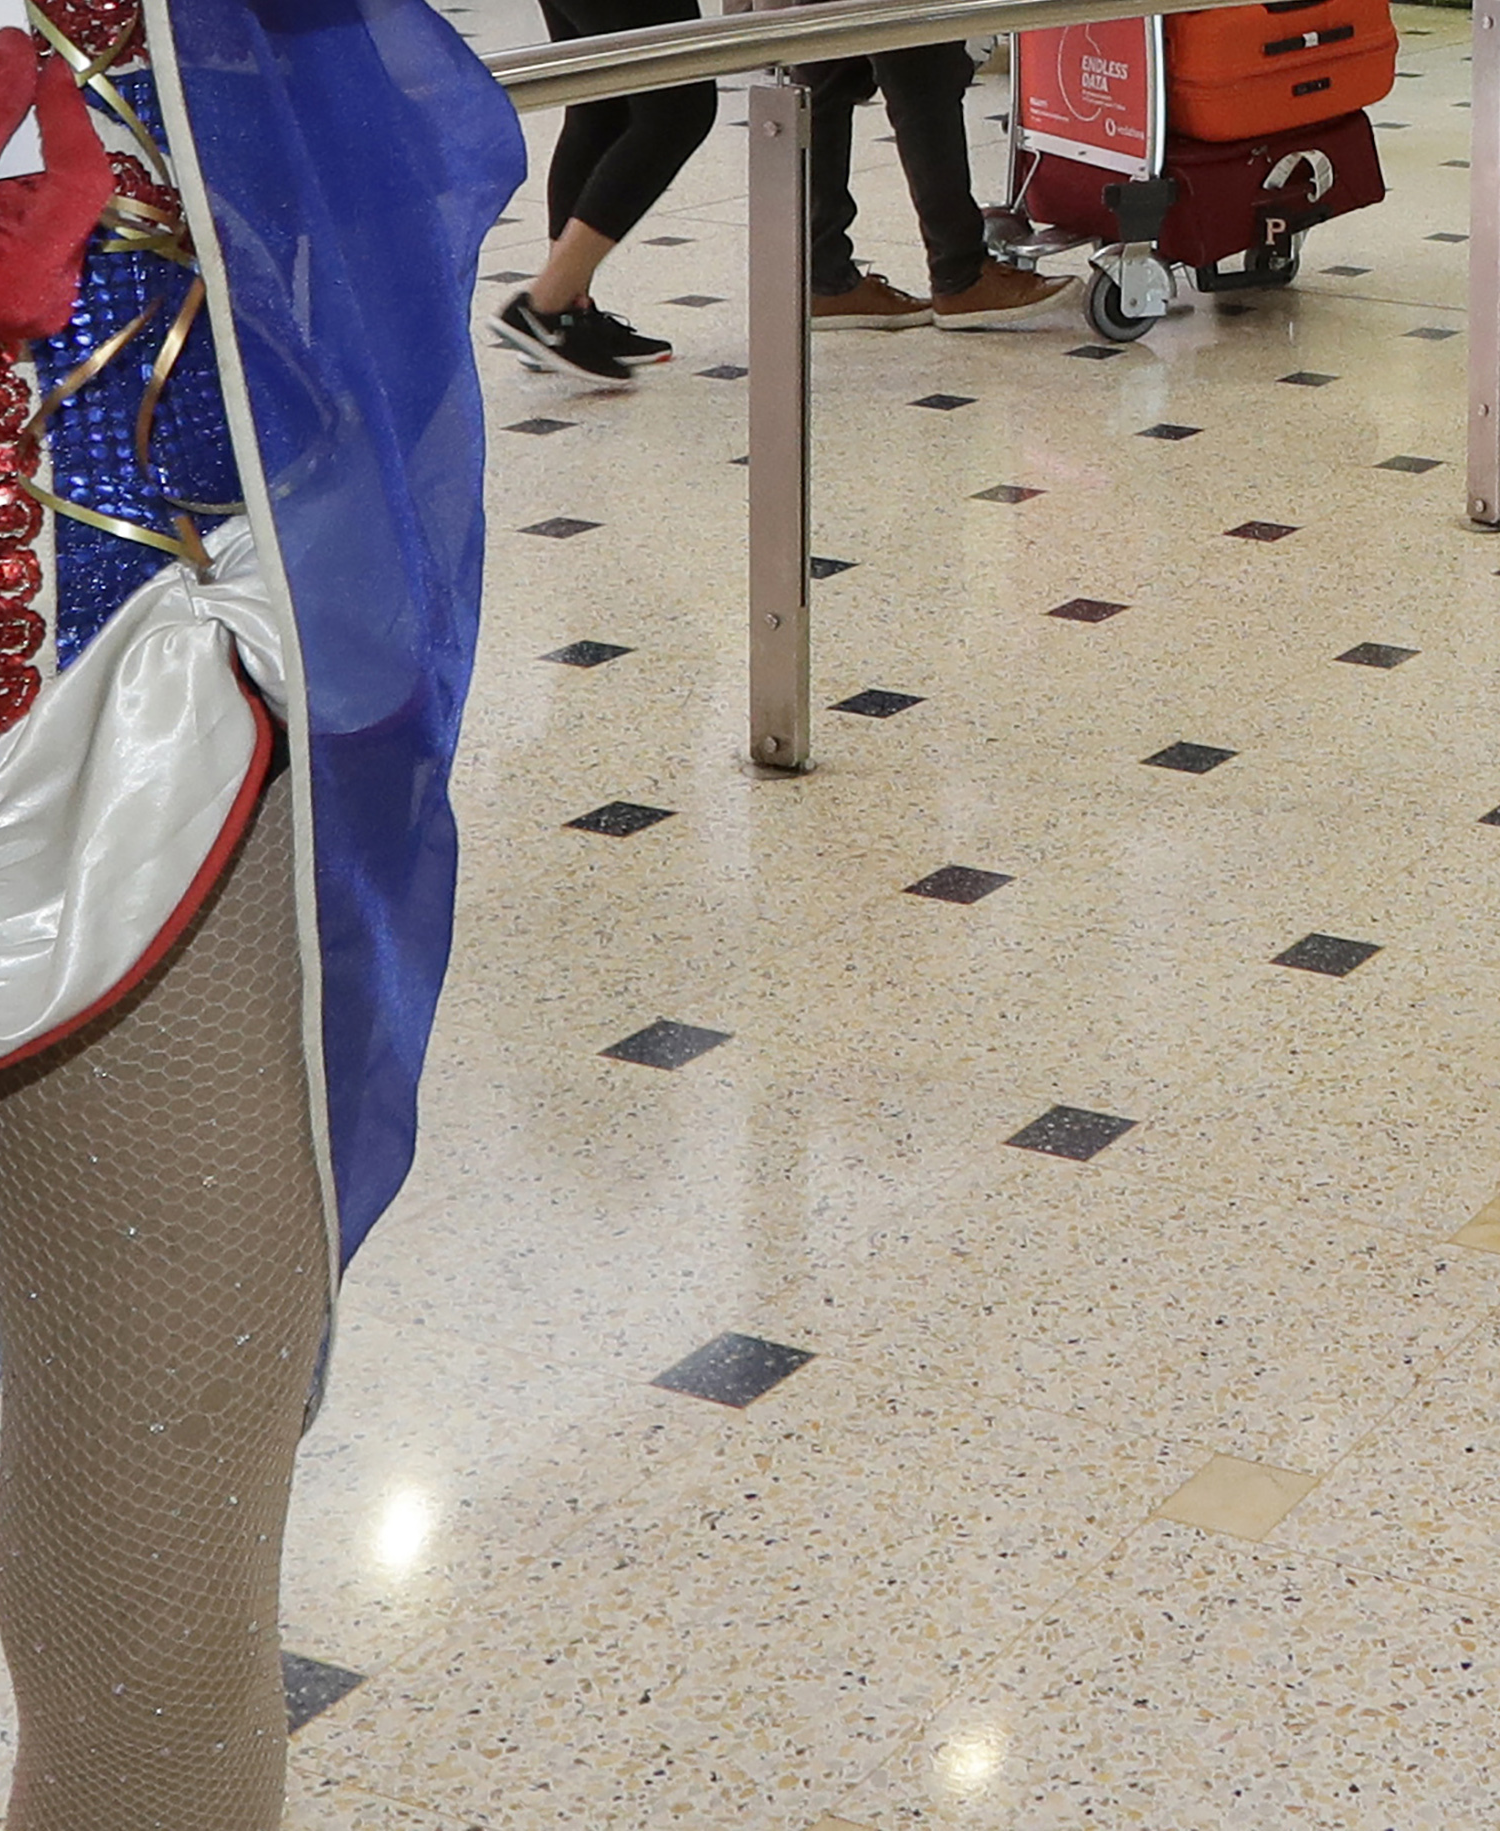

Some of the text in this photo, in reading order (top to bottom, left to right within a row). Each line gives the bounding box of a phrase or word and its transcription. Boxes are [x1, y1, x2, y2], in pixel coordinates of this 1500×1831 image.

[1081, 55, 1129, 80] ENDLESS
[1081, 72, 1109, 92] DATA
[1265, 218, 1287, 245] P
